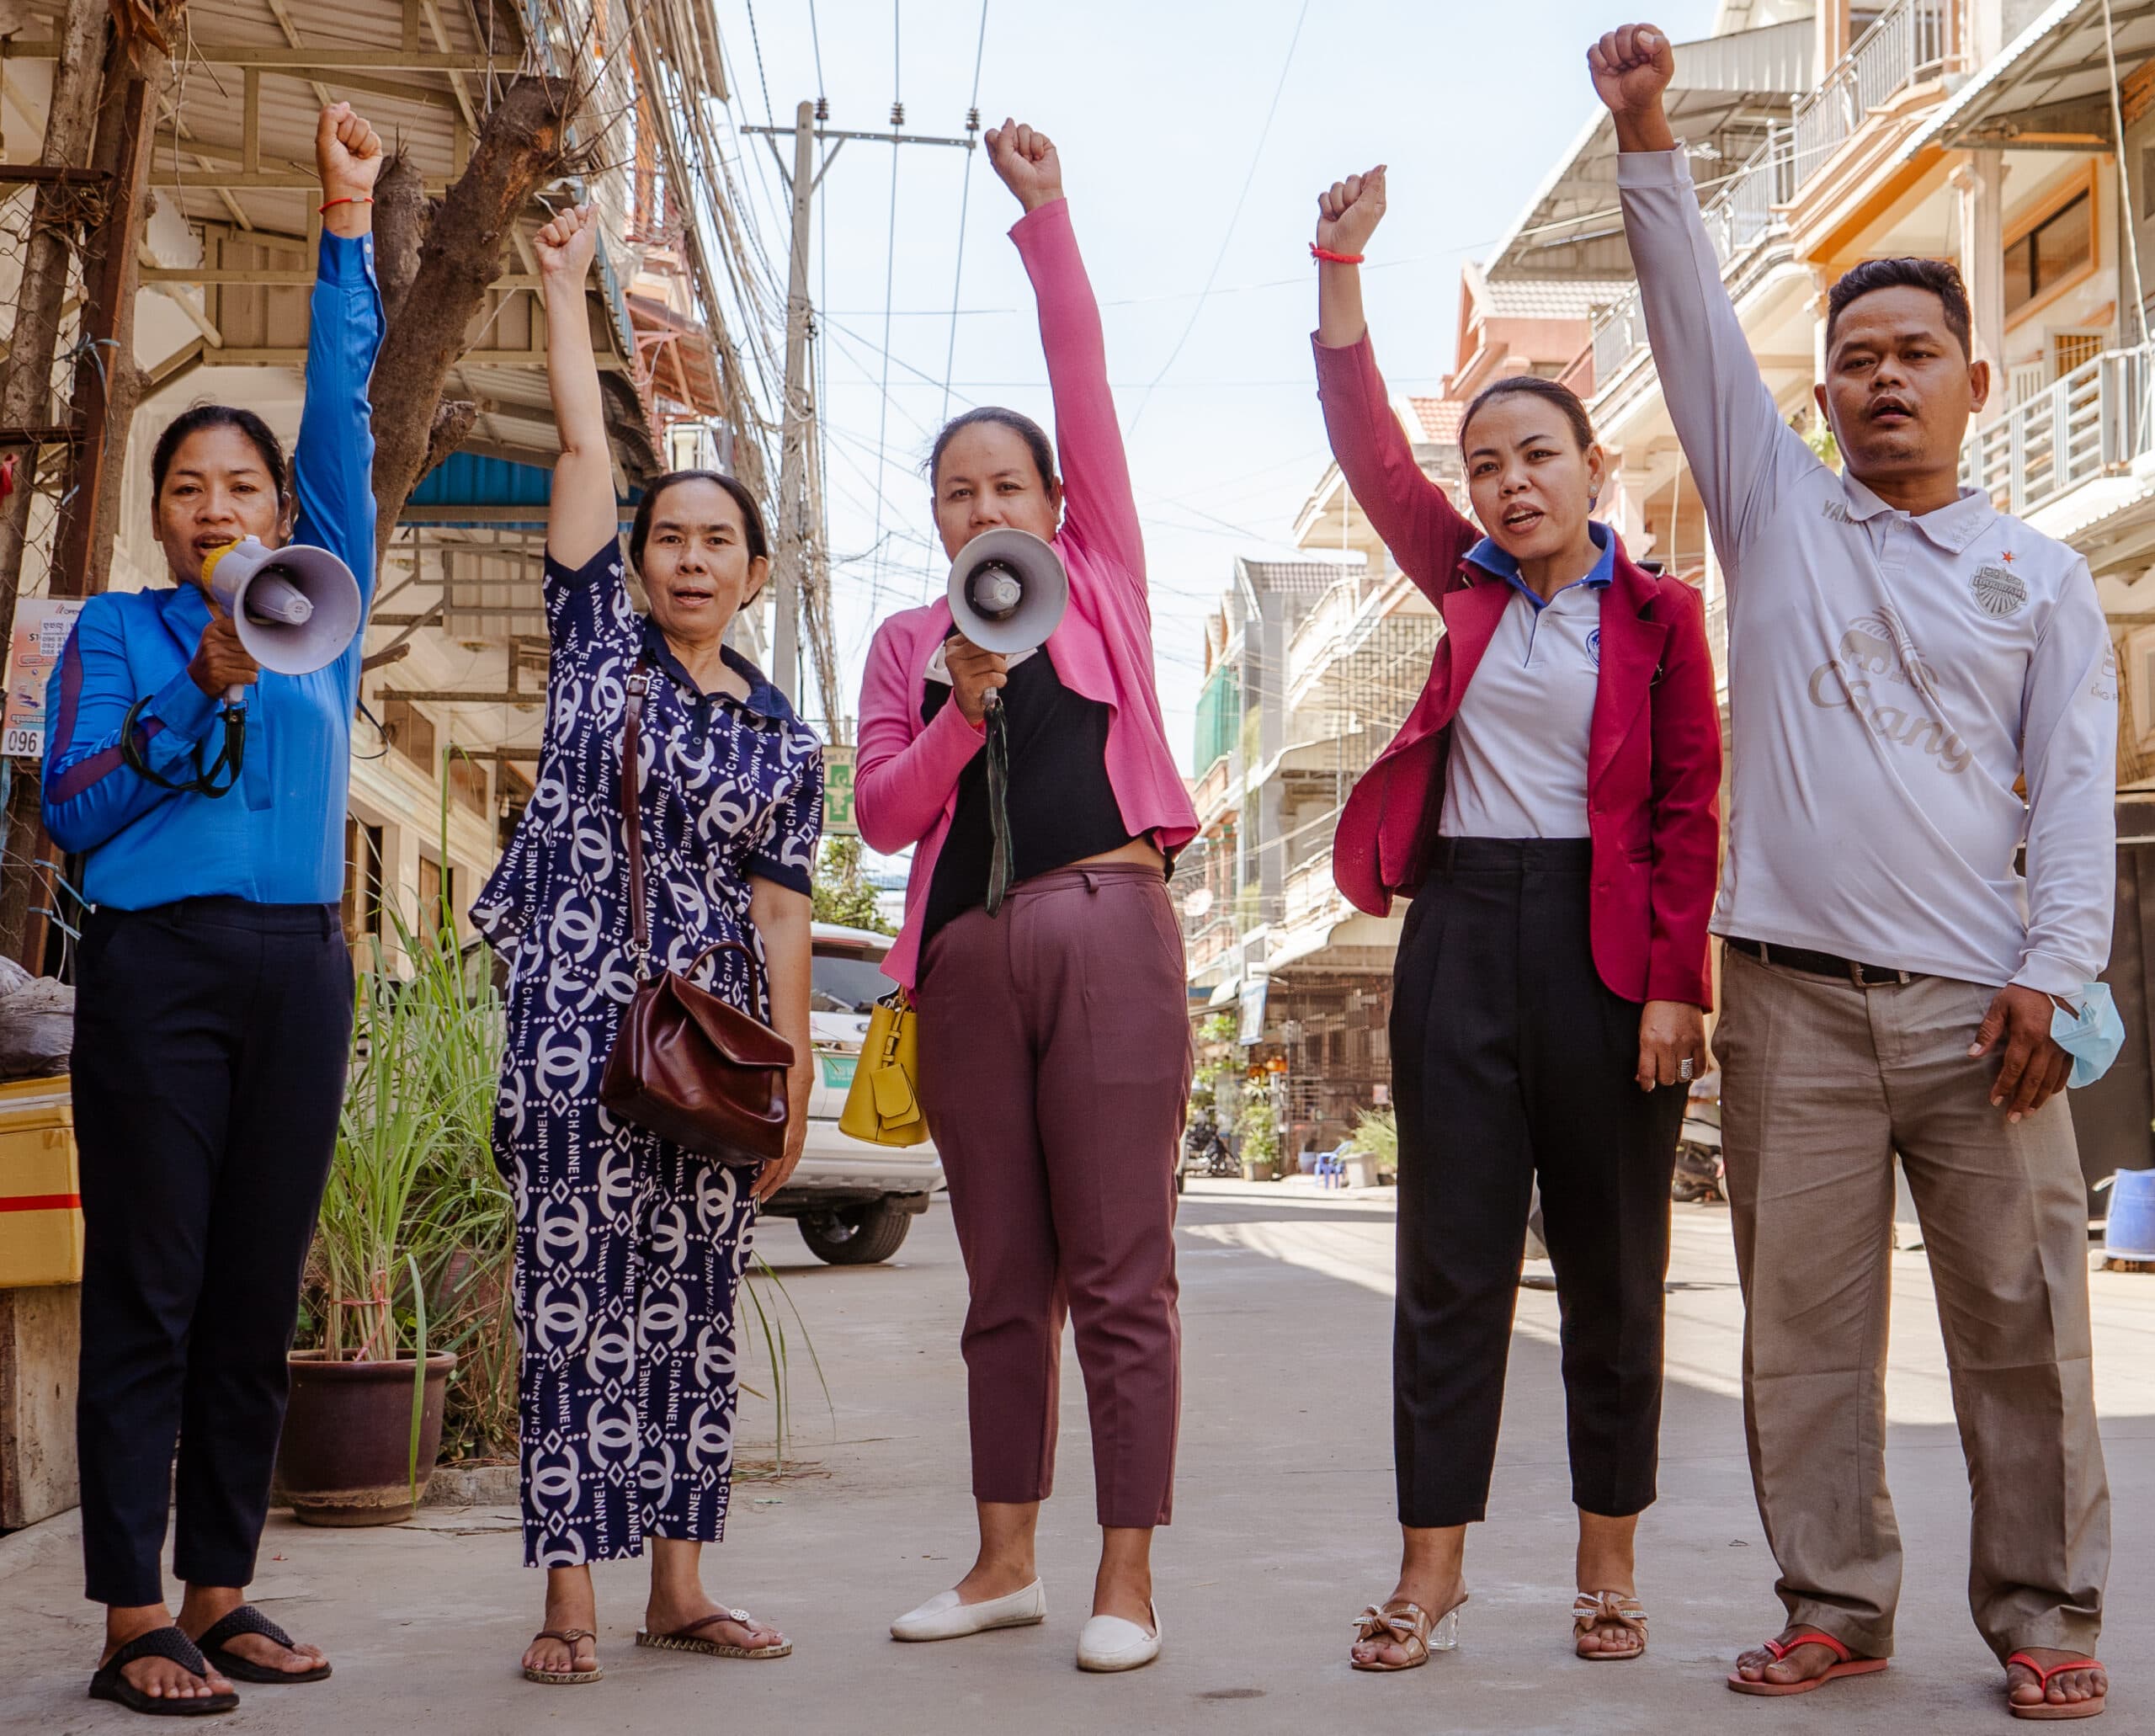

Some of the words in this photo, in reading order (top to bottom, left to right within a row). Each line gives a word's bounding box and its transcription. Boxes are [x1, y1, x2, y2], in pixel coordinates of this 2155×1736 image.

[8, 730, 38, 753] 096
[576, 723, 593, 793] CHANNEL
[655, 783, 672, 849] CHANNEL
[492, 833, 527, 899] CHANNEL
[524, 840, 539, 913] CHANNEL
[516, 988, 533, 1056] CHANNEL
[536, 1110, 549, 1184] CHANNEL
[567, 1108, 580, 1184] CHANNEL
[597, 1233, 611, 1307] CHANNEL
[705, 1247, 715, 1315] CHANNEL
[531, 1364, 546, 1435] CHANNEL
[558, 1361, 571, 1434] CHANNEL
[636, 1361, 652, 1430] CHANNEL
[666, 1359, 682, 1430] CHANNEL
[593, 1481, 609, 1554] CHANNEL
[625, 1480, 641, 1552] CHANNEL
